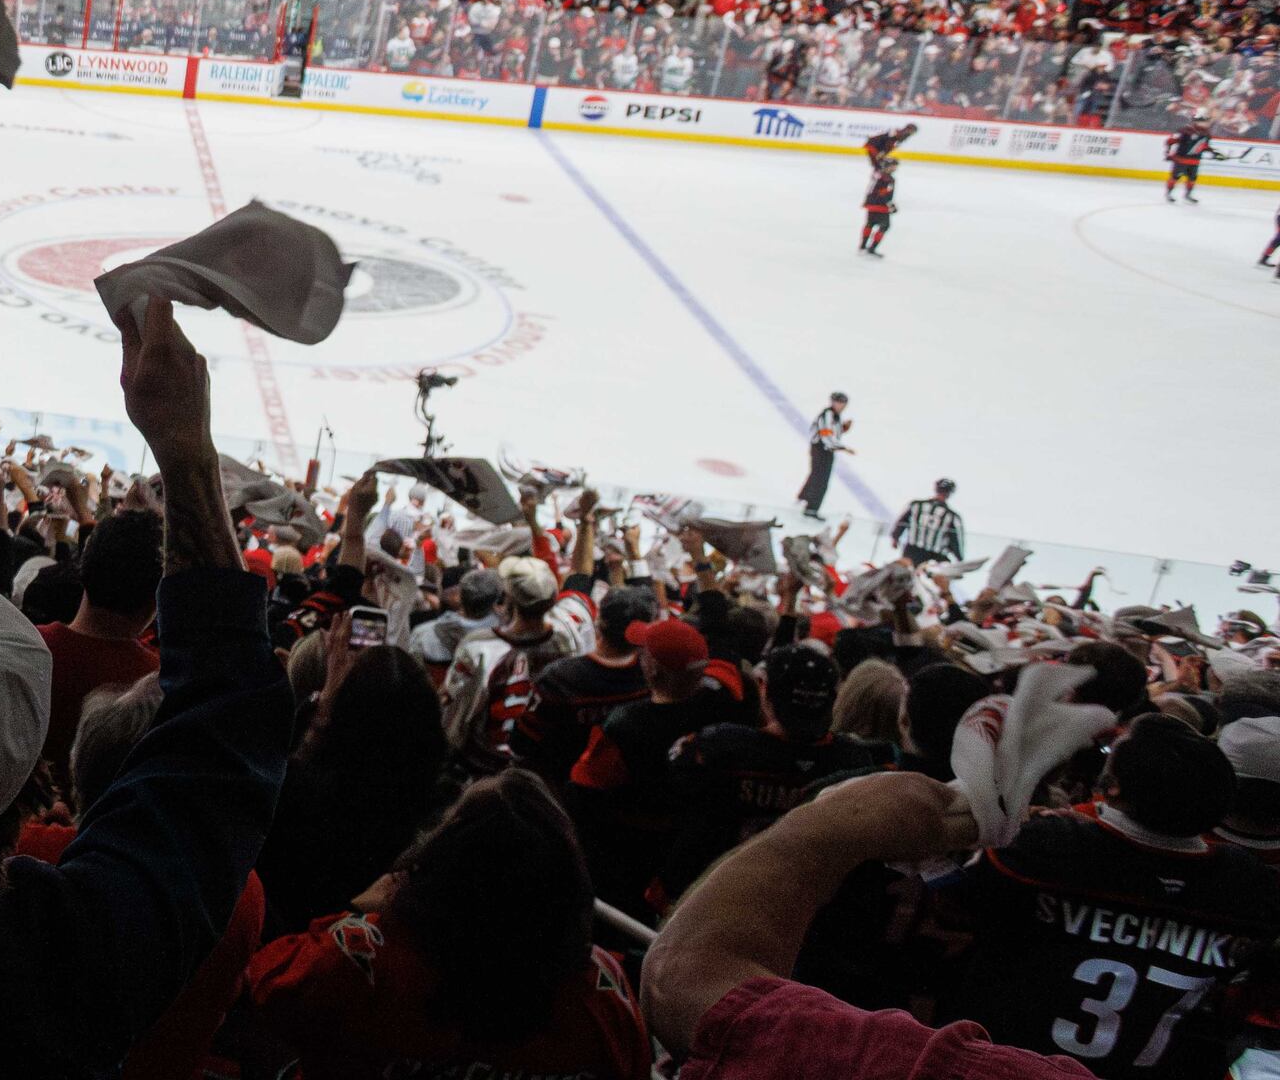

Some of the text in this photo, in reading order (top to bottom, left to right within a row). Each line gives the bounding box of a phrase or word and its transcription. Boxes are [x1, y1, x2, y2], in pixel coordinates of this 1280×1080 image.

[77, 54, 169, 76] LYNNWOOD
[209, 63, 263, 83] RALEIGH
[76, 70, 121, 82] BREWING
[427, 90, 490, 112] Lottery
[625, 103, 703, 124] PEPSI
[48, 183, 180, 199] Center
[1049, 956, 1218, 1068] 37
